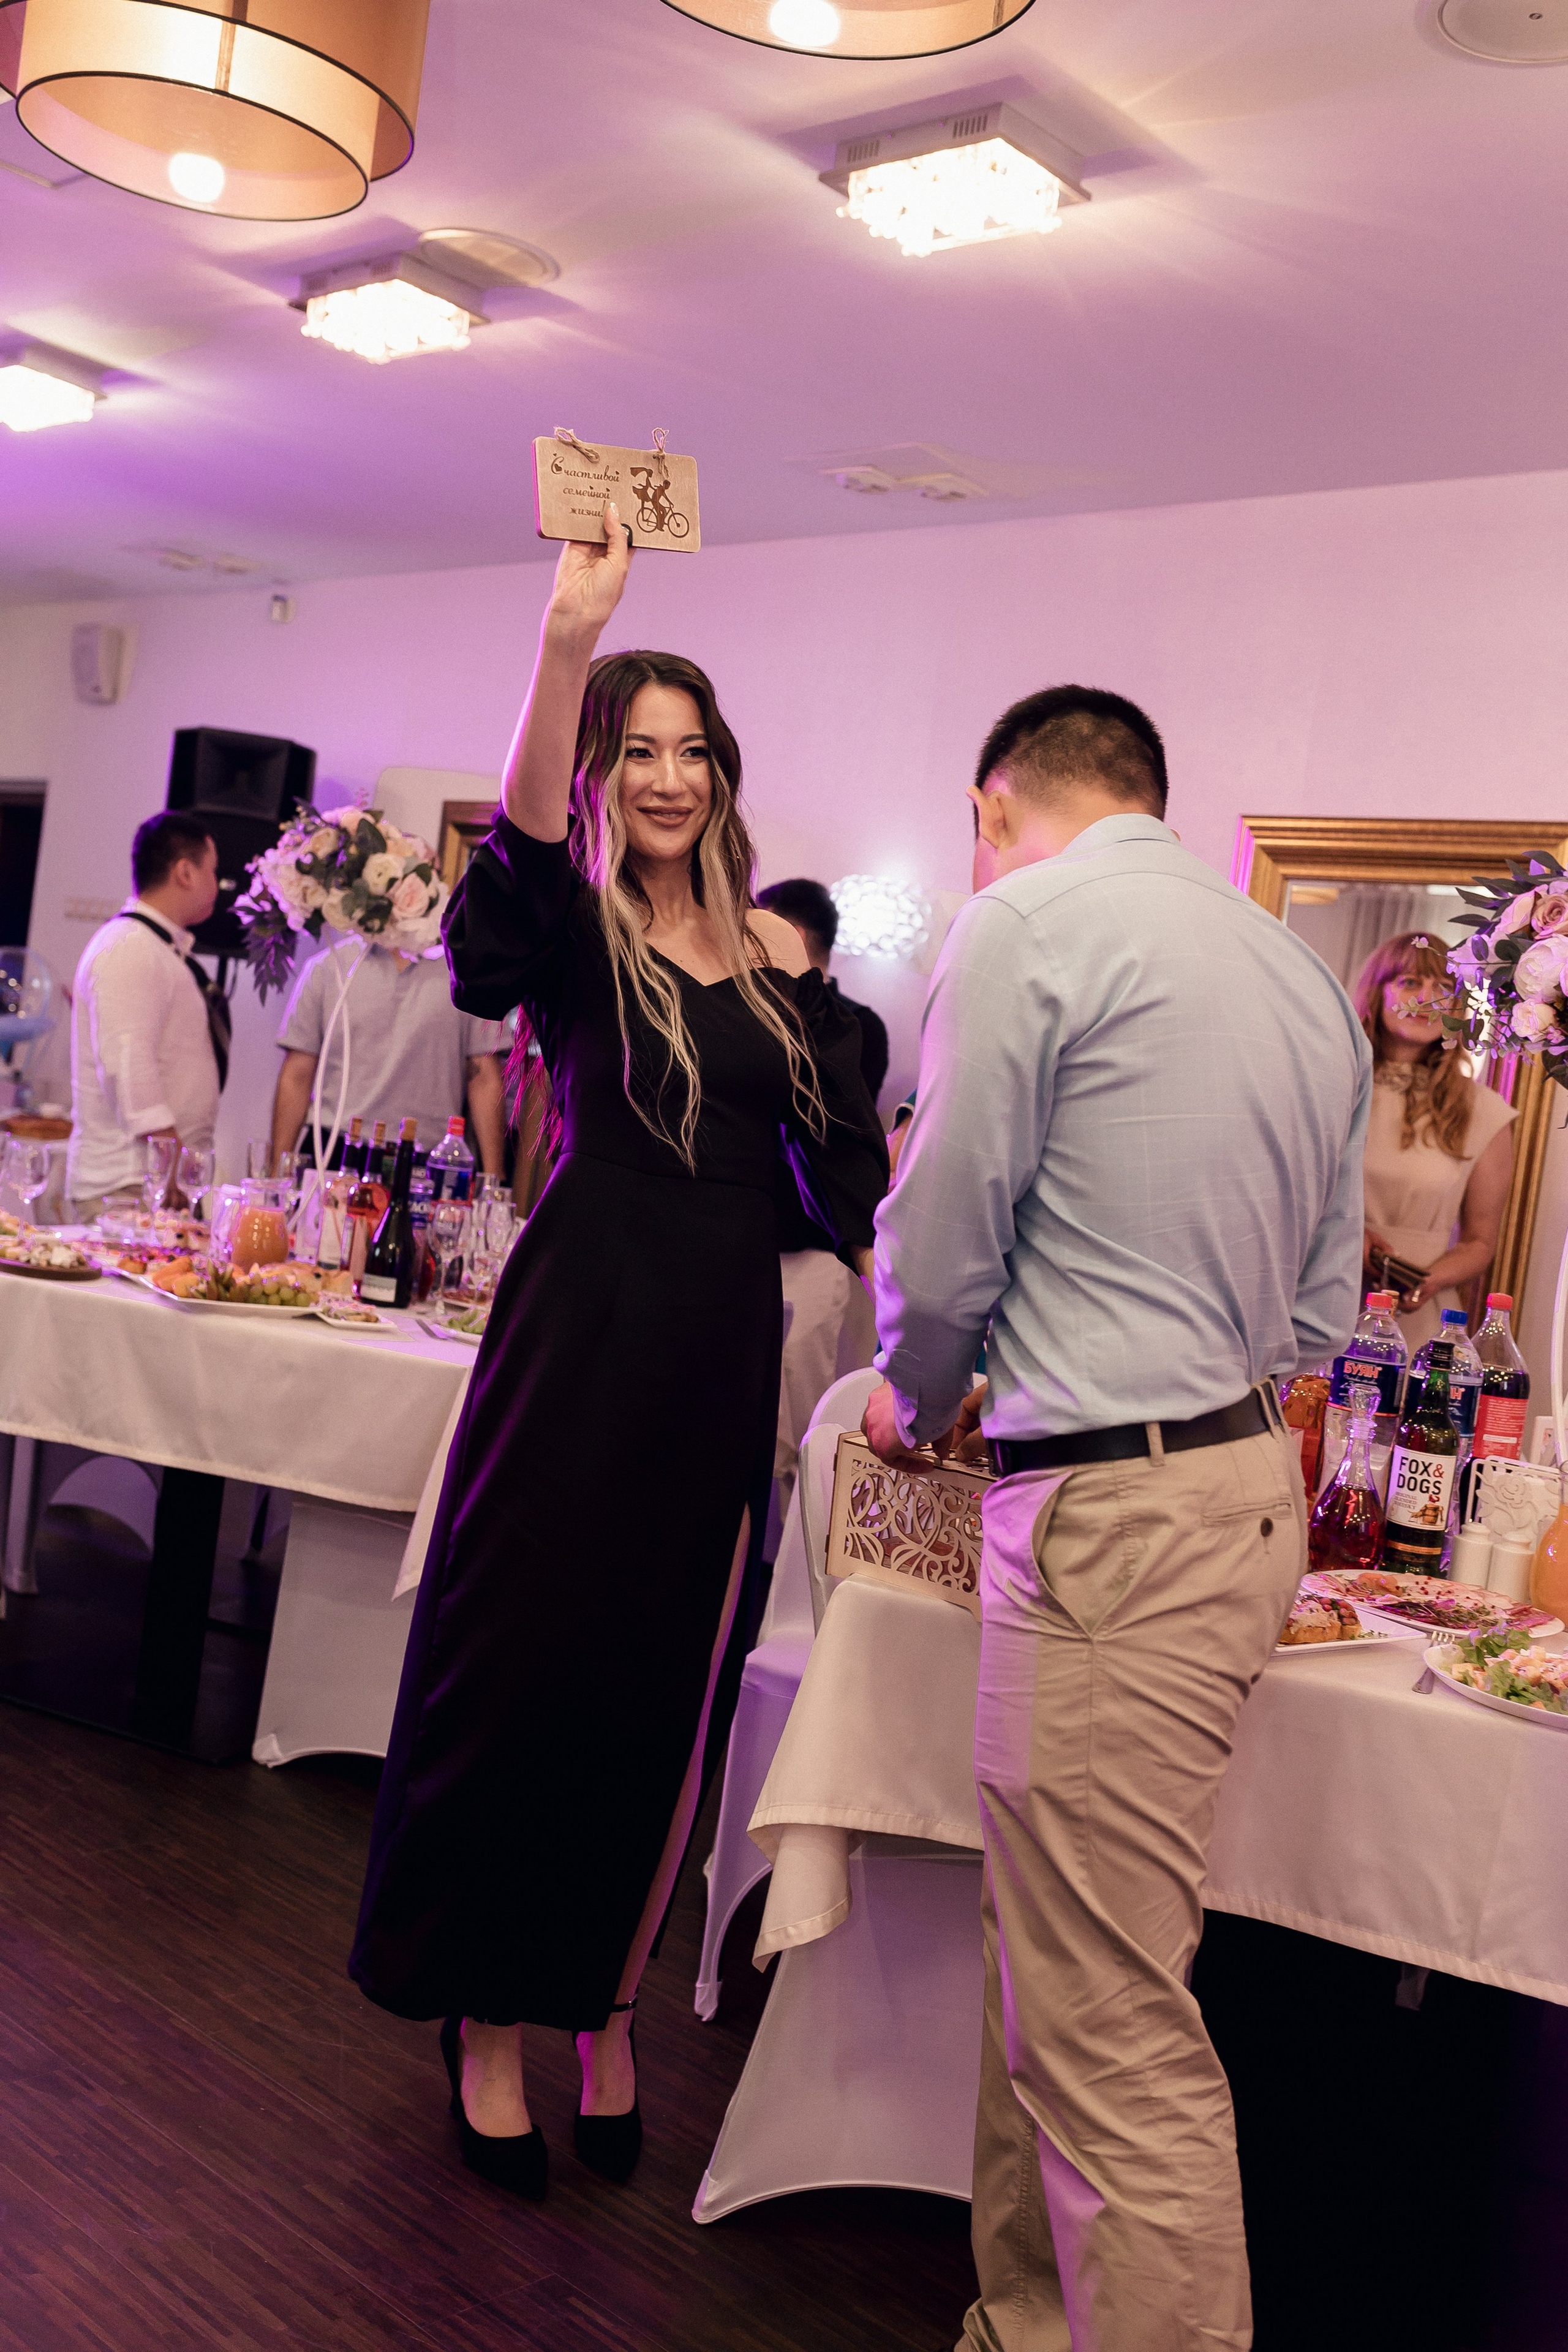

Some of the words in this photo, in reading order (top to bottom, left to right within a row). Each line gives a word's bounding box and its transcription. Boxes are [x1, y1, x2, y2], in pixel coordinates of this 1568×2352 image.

[551, 454, 620, 482] Счастливой
[563, 485, 611, 499] семейной
[569, 499, 606, 518] жизни!
[1343, 1361, 1379, 1379] БУЯН
[1396, 1472, 1442, 1495] DOGS
